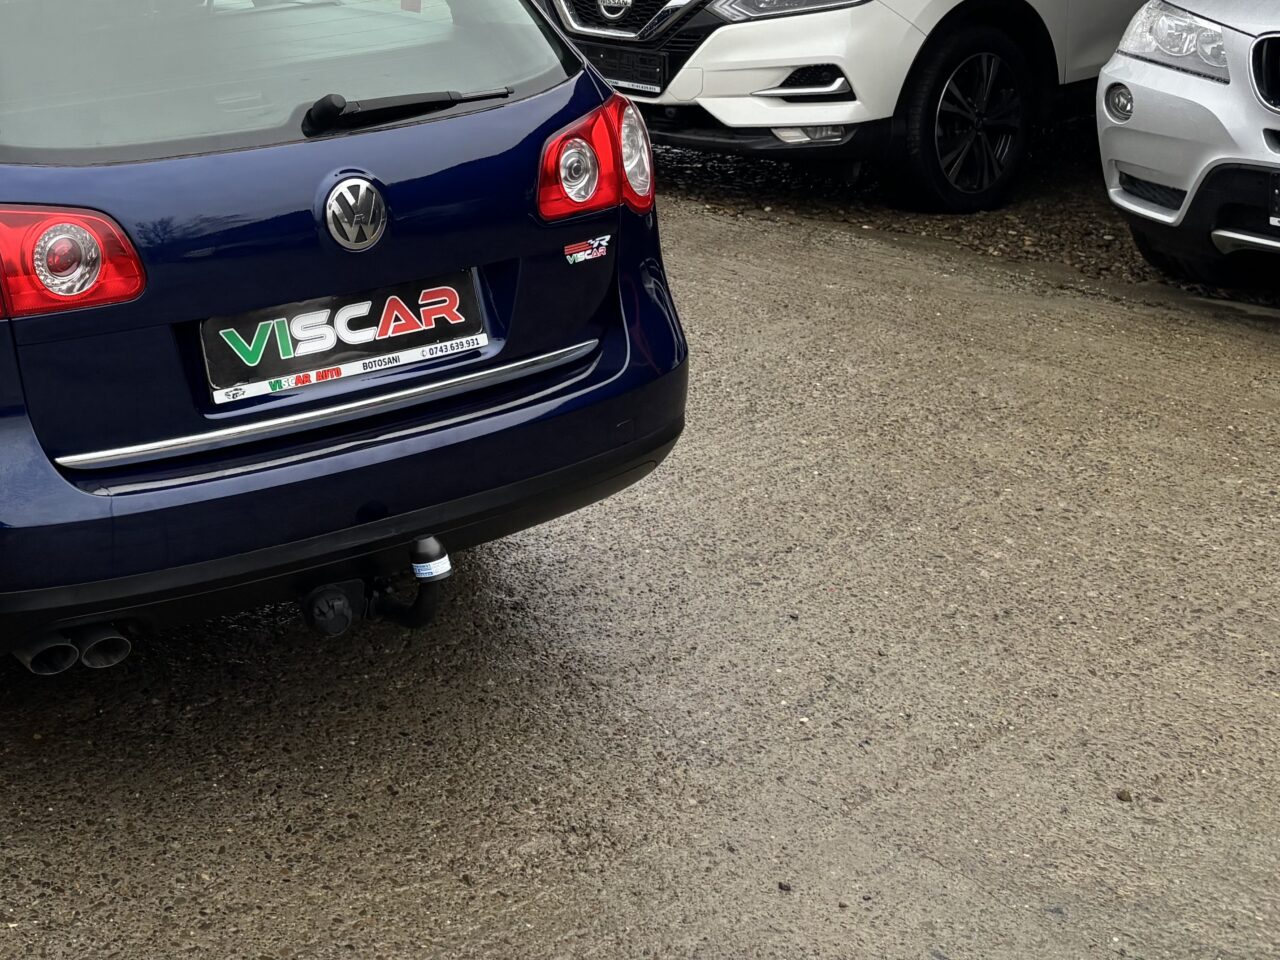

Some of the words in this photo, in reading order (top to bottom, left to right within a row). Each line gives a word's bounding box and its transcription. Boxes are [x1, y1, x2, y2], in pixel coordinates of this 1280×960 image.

[566, 246, 607, 265] VISCAR
[220, 286, 465, 366] VISCAR
[269, 373, 312, 391] VISCAR
[315, 367, 342, 382] AUTO
[362, 355, 401, 371] BOTOSANI
[428, 338, 480, 356] 0743.639.931
